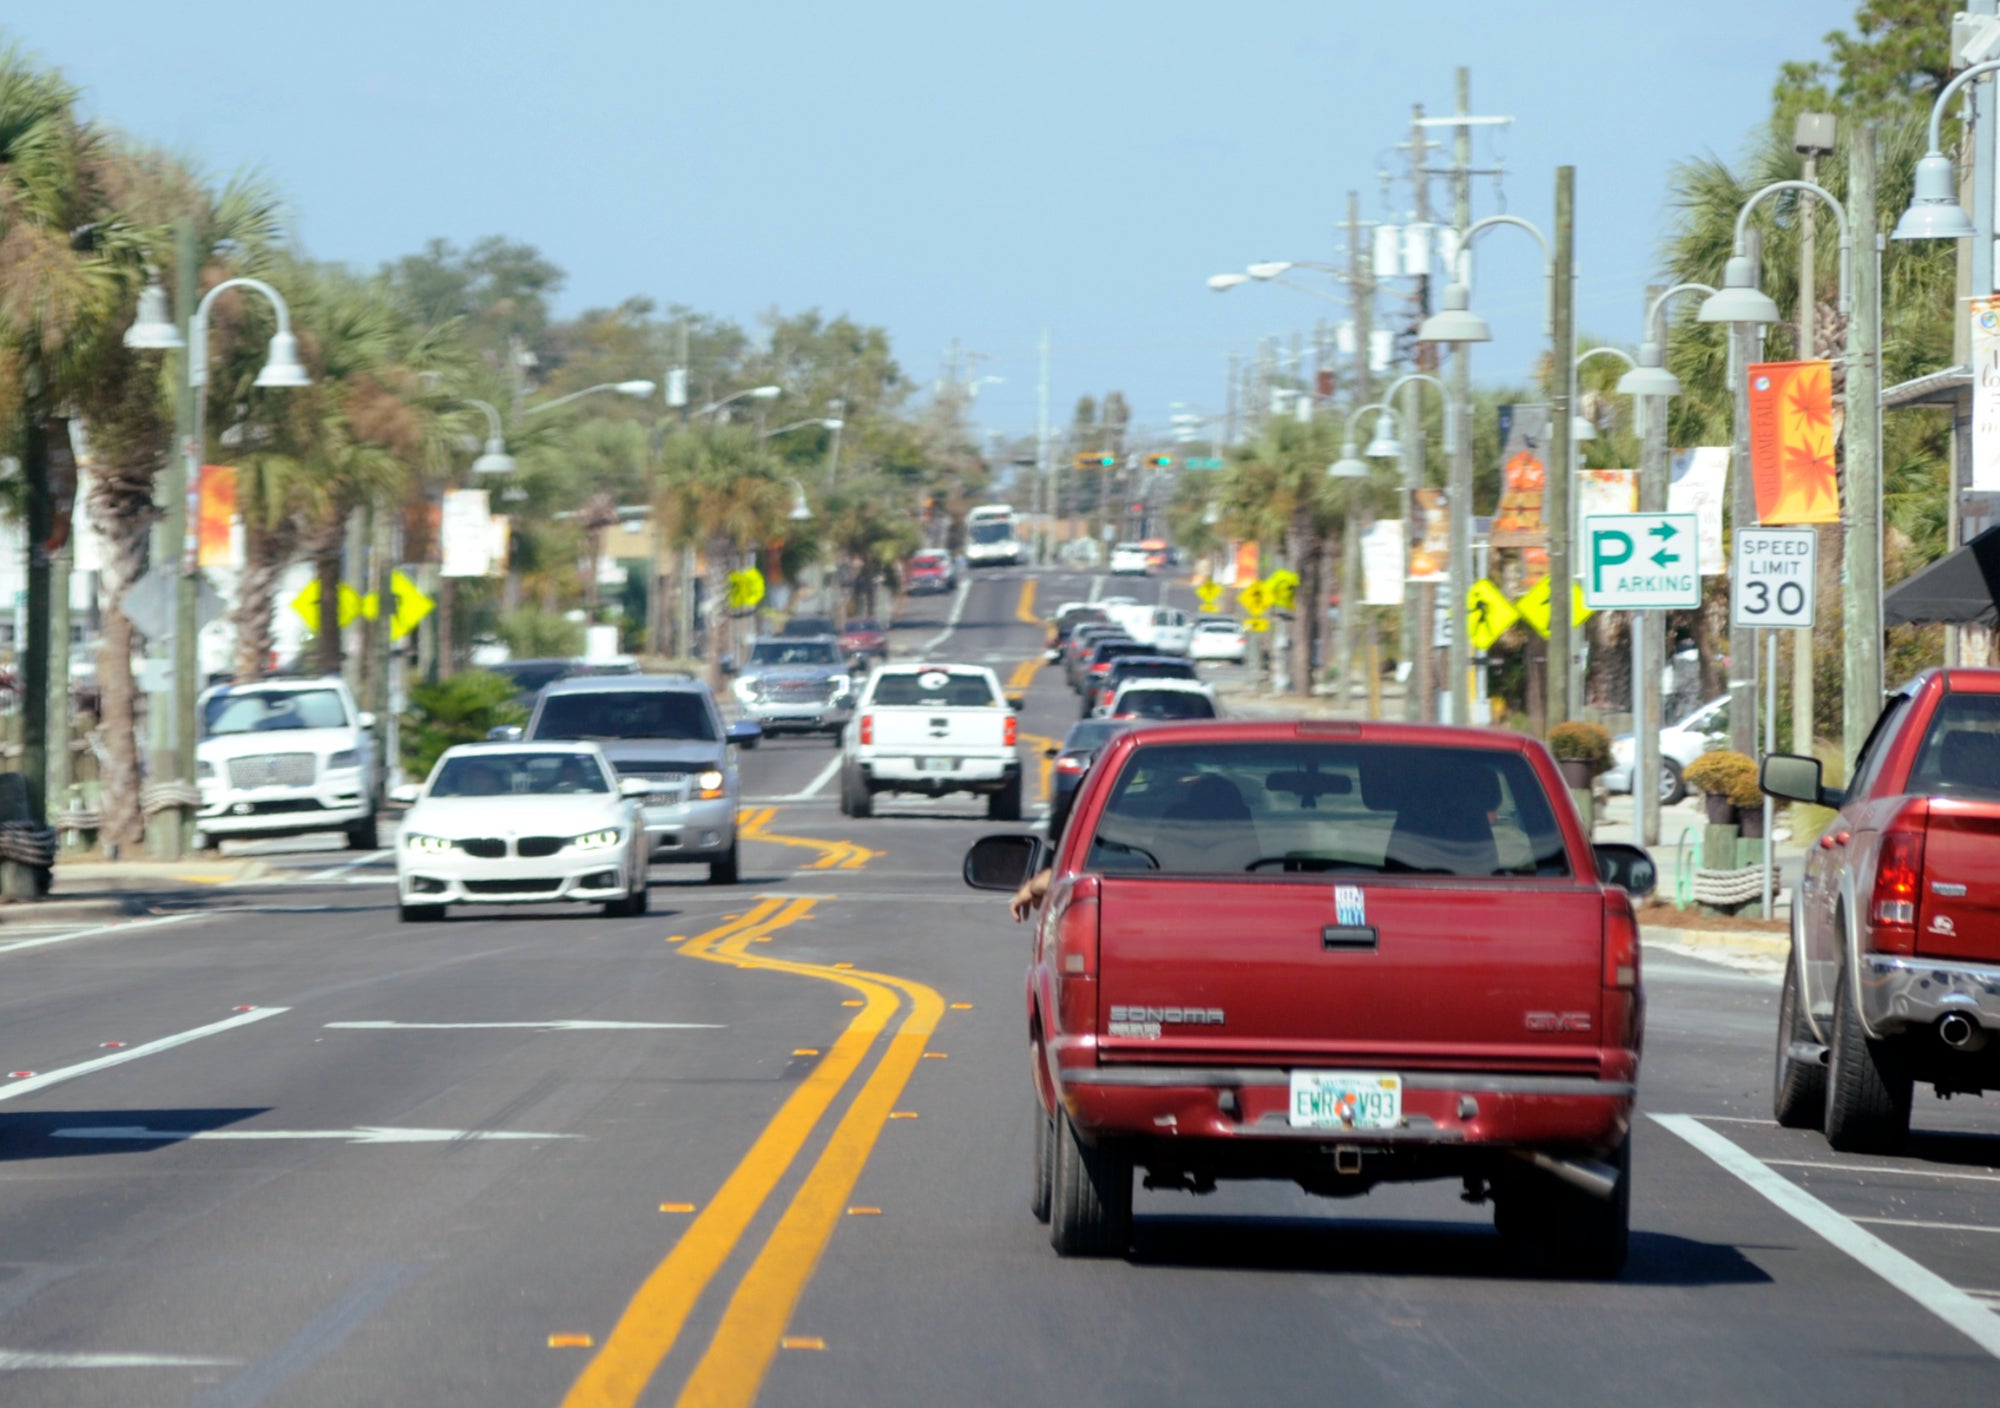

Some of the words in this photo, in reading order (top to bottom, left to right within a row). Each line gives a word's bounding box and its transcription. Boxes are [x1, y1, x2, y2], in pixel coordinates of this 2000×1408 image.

[1743, 539, 1810, 557] SPEED
[1749, 560, 1801, 576] LIMIT
[1743, 581, 1806, 616] 30
[1110, 1005, 1226, 1025] SONOMA
[1524, 1011, 1591, 1032] GMC
[1297, 1091, 1333, 1117] EWR
